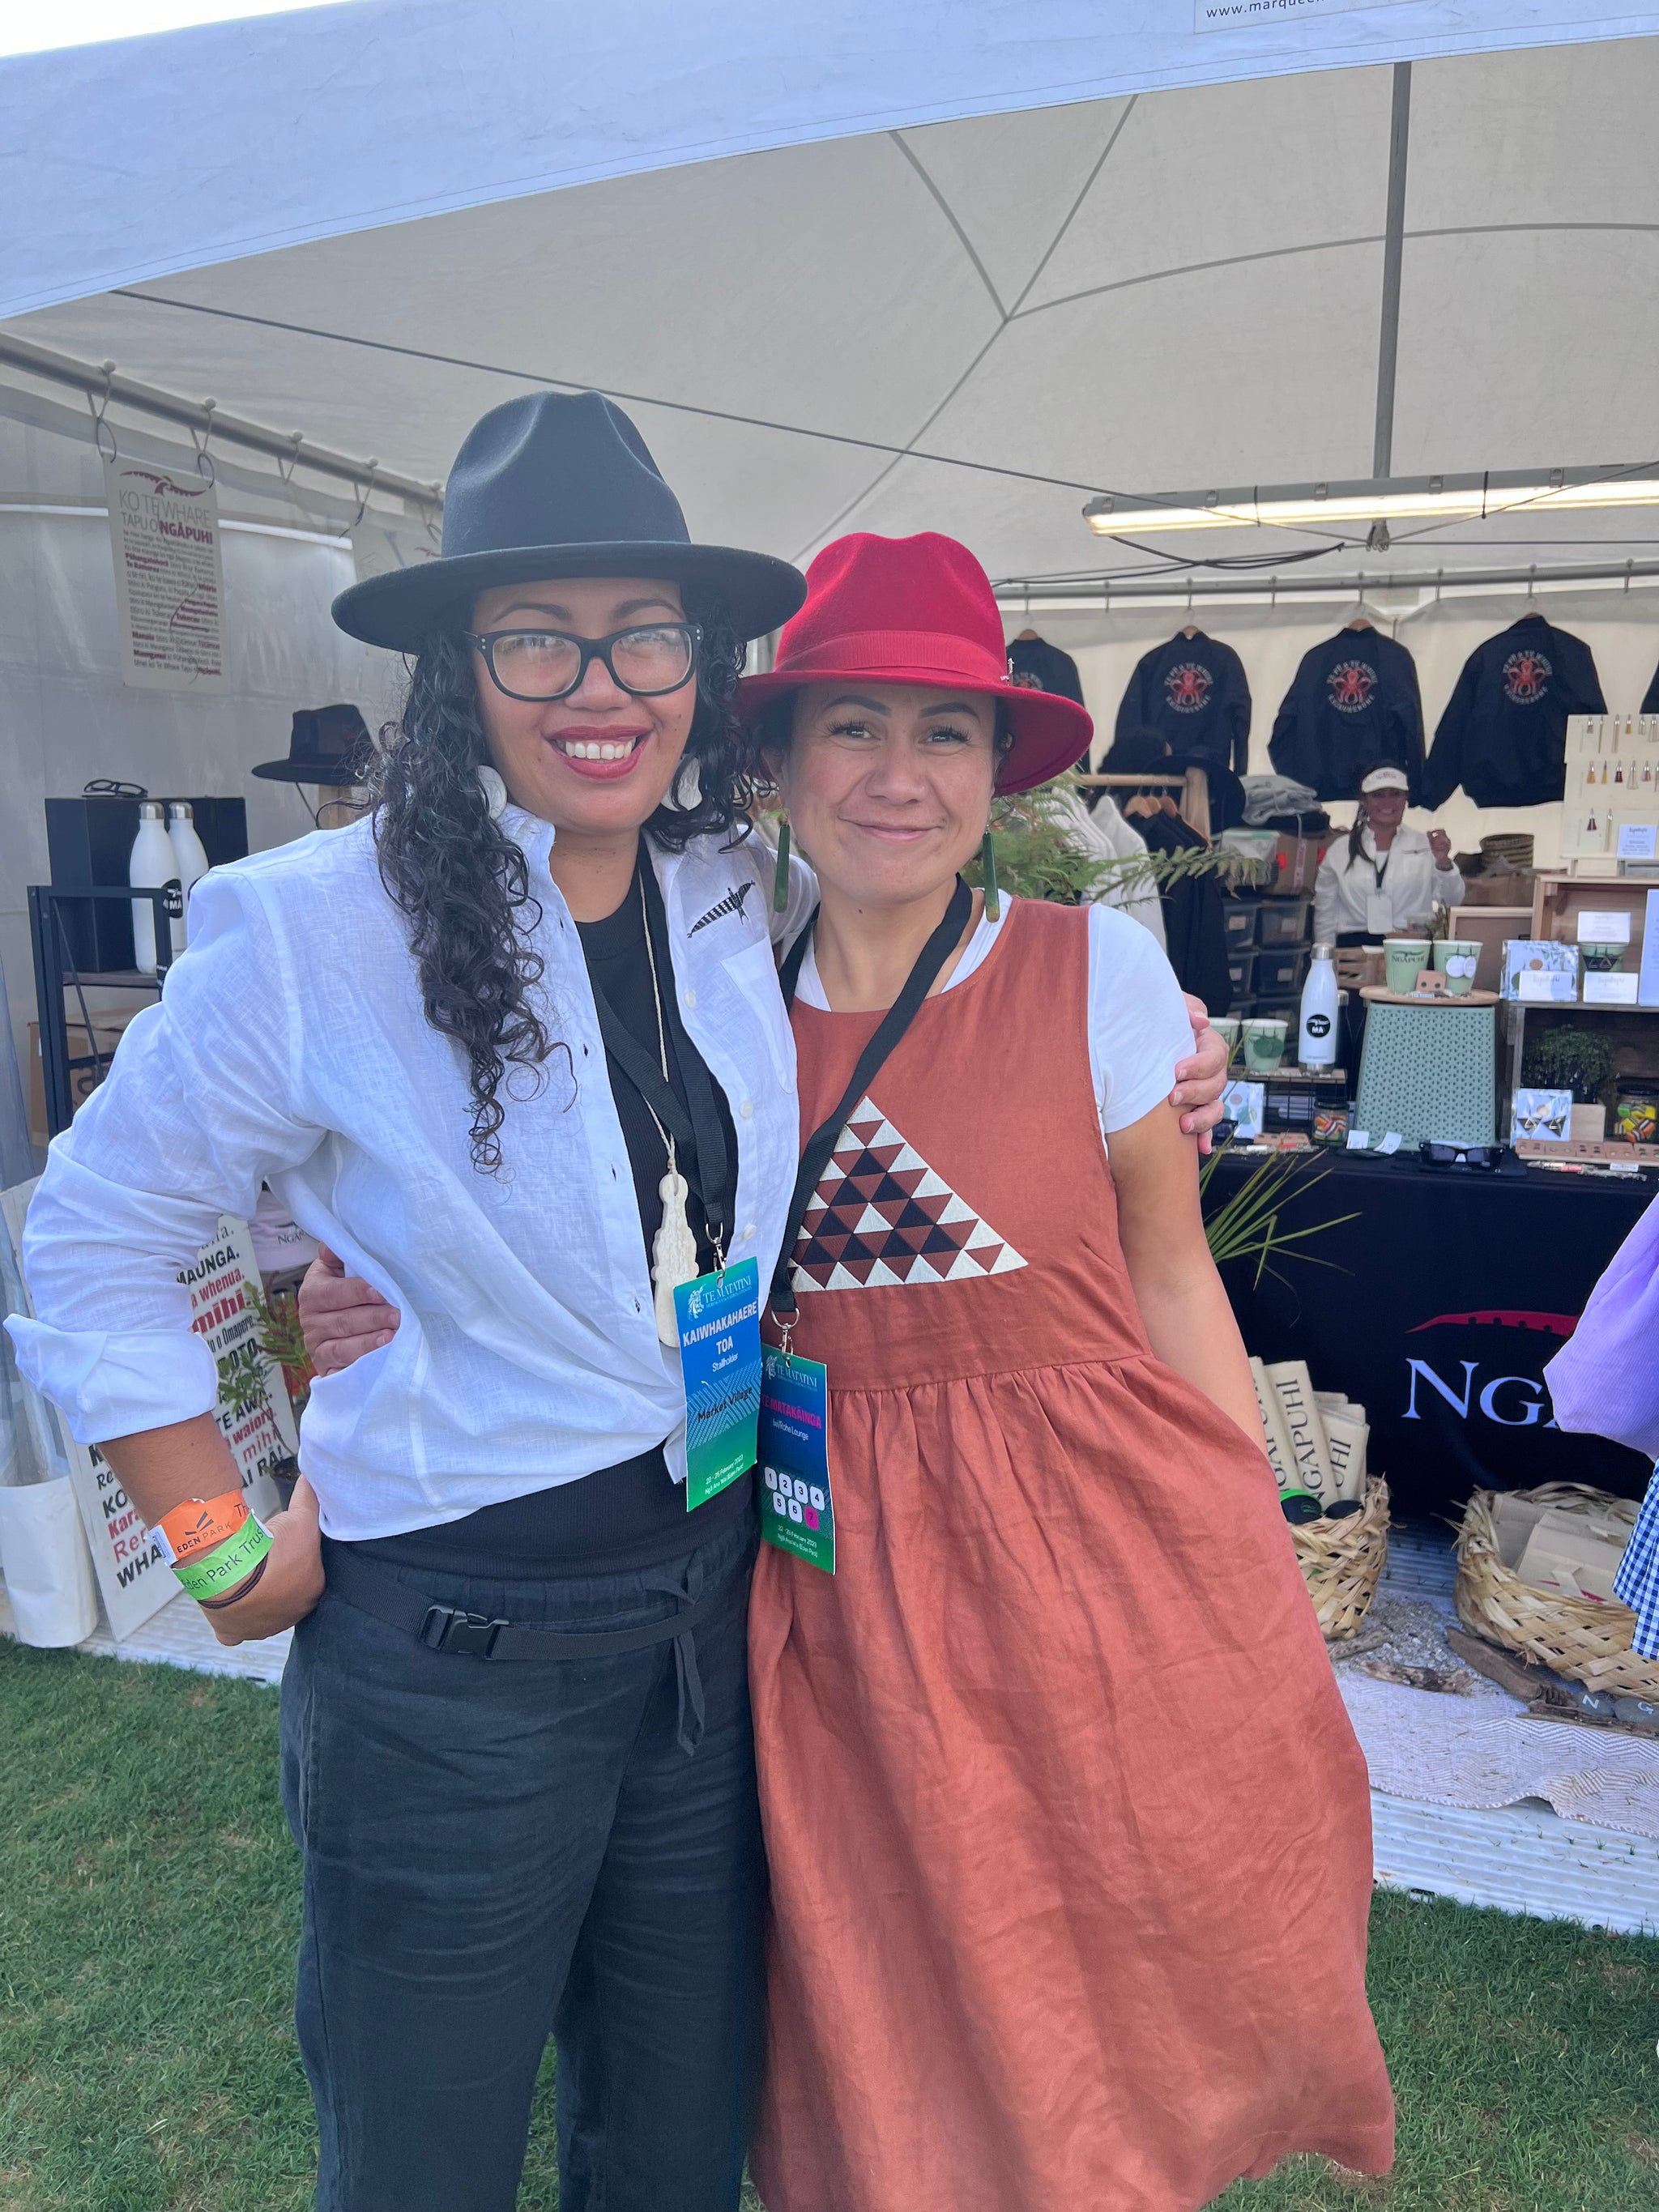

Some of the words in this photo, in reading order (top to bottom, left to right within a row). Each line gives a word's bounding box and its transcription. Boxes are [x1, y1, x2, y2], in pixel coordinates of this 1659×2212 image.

[1205, 0, 1324, 18] www.marque
[118, 488, 140, 511] KO
[141, 492, 160, 516] TE
[162, 497, 211, 529] WHARE
[121, 511, 148, 531] TAPU
[198, 1268, 245, 1303] whenua.
[716, 1275, 752, 1298] MATATINI
[191, 1289, 251, 1335] mihi.
[682, 1301, 757, 1348] KAIWHAKAHAERE
[216, 1335, 223, 1349] o
[716, 1335, 734, 1355] TOA
[712, 1353, 739, 1372] Stallholder
[786, 1367, 817, 1387] MATATINI
[1401, 1357, 1559, 1429] NG
[697, 1401, 727, 1423] Market
[728, 1386, 753, 1405] Village
[791, 1426, 809, 1442] Lounge
[783, 1480, 788, 1489] 2
[799, 1486, 804, 1495] 3
[814, 1494, 820, 1502] 4
[777, 1498, 782, 1507] 5
[792, 1506, 798, 1515] 6
[177, 1536, 202, 1554] EDEN
[203, 1521, 232, 1540] PARK
[181, 1578, 208, 1590] den
[206, 1554, 243, 1583] Park
[238, 1528, 265, 1554] Trus
[1582, 1694, 1600, 1710] N
[1637, 1702, 1654, 1715] G
